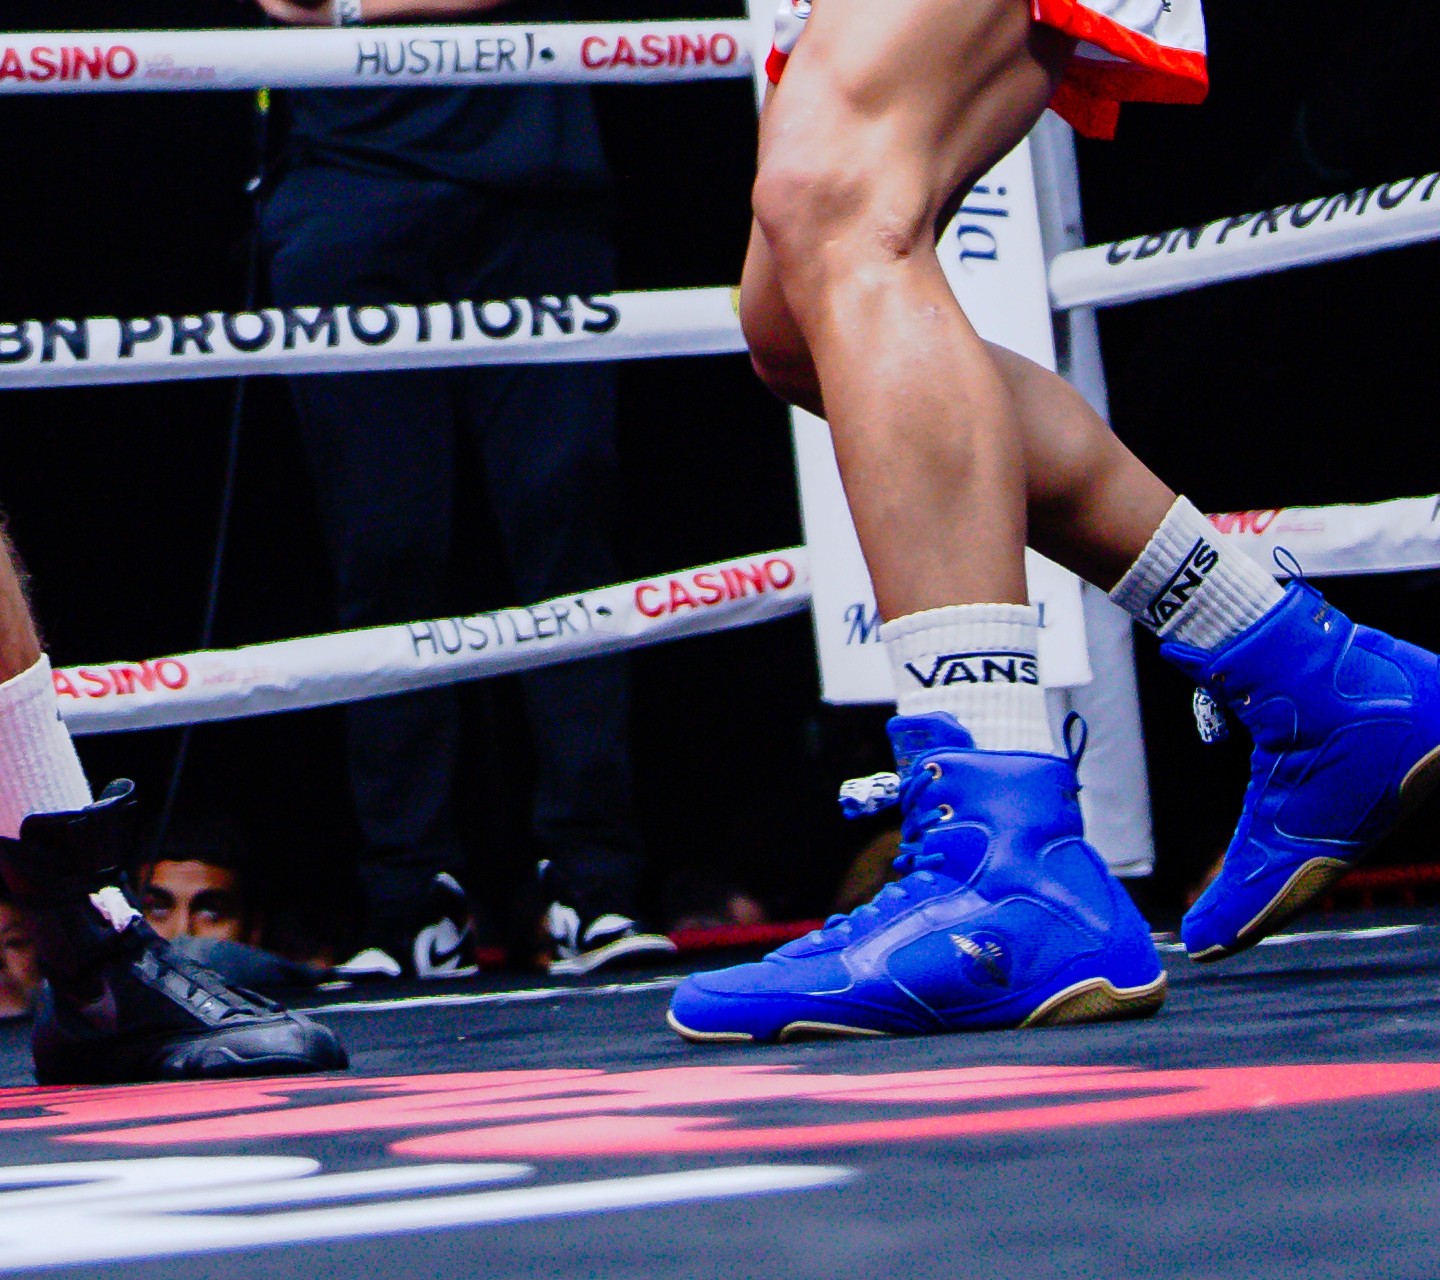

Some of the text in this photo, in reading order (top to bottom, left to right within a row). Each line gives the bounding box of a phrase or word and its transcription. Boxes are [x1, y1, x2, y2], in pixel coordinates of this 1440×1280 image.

[355, 32, 739, 76] HUSTLER CASINO
[119, 293, 622, 358] PROMOTIONS
[406, 558, 797, 658] HUSTLER CASINO
[1138, 536, 1220, 628] VANS
[51, 657, 189, 699] ASINO
[904, 649, 1039, 689] VANS
